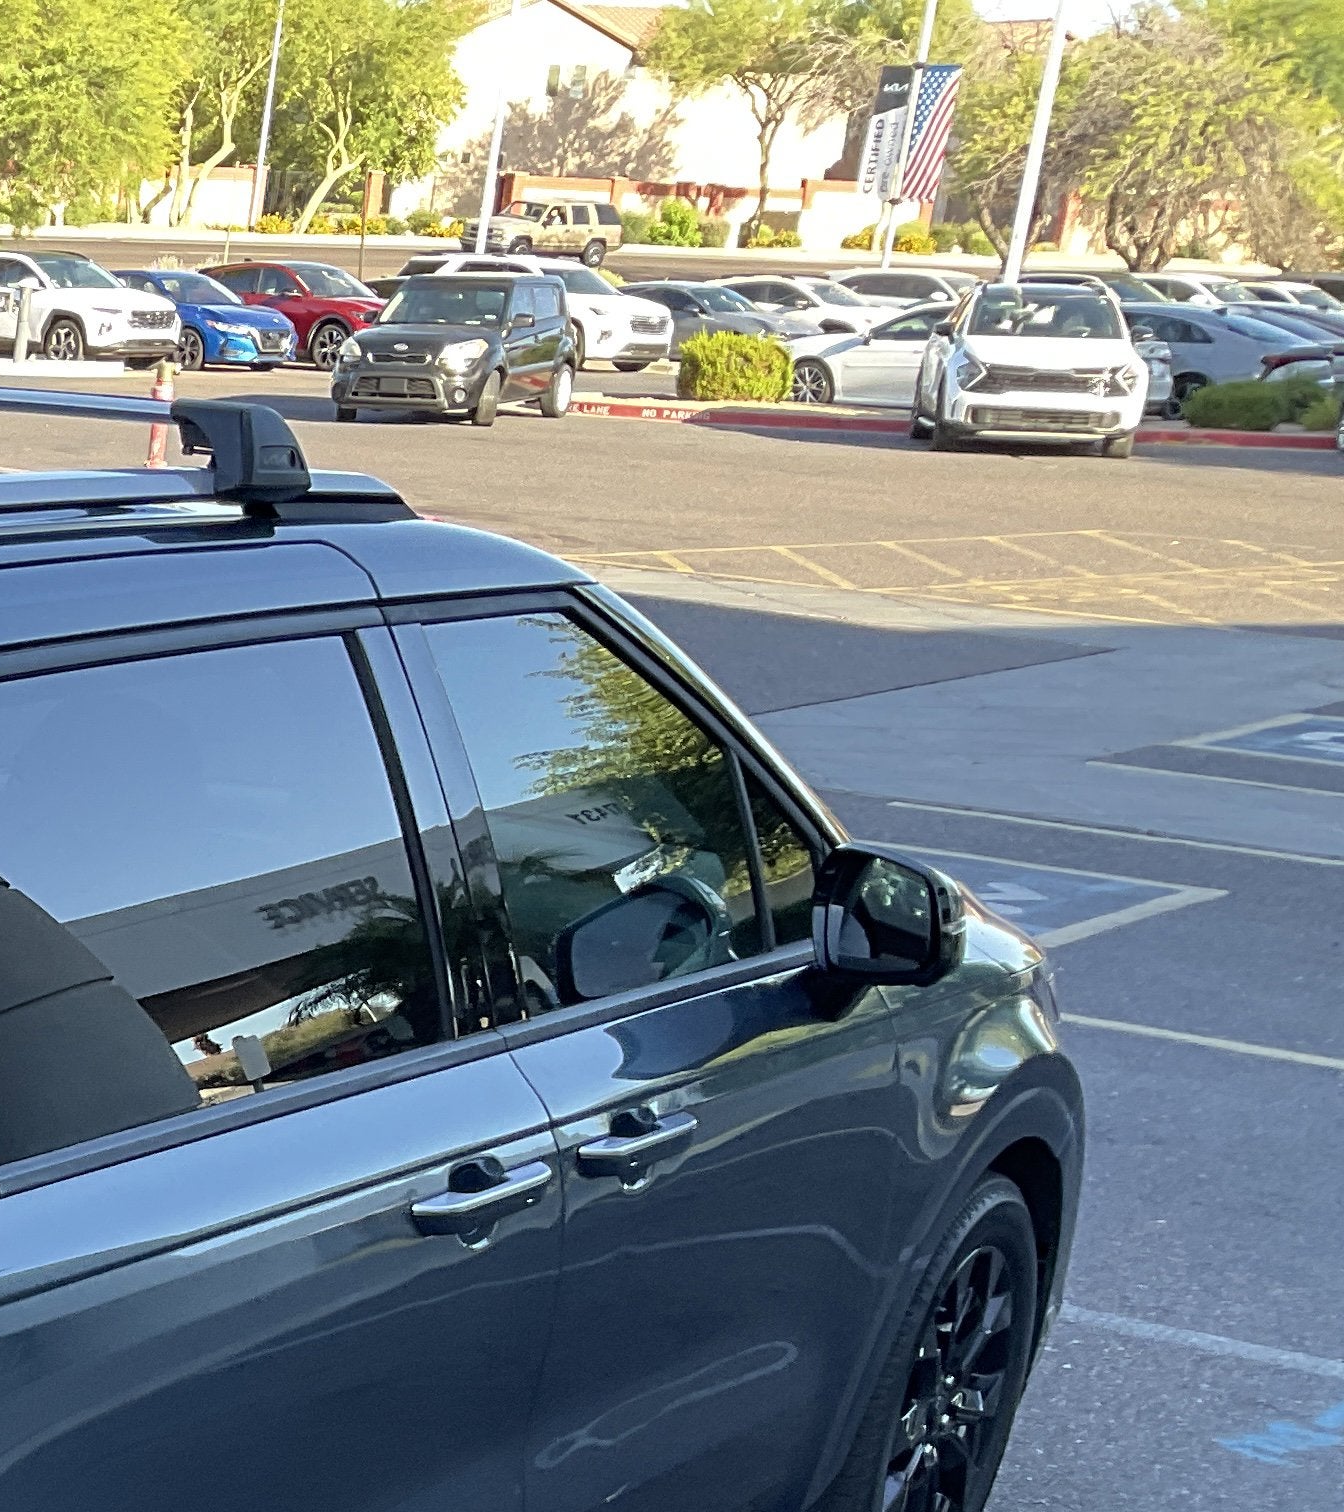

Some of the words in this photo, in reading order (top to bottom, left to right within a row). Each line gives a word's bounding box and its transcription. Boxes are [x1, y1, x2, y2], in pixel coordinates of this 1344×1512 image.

[883, 82, 909, 92] KIA
[862, 118, 885, 194] CERTIFIED
[583, 404, 611, 415] LANE
[642, 408, 657, 418] NO
